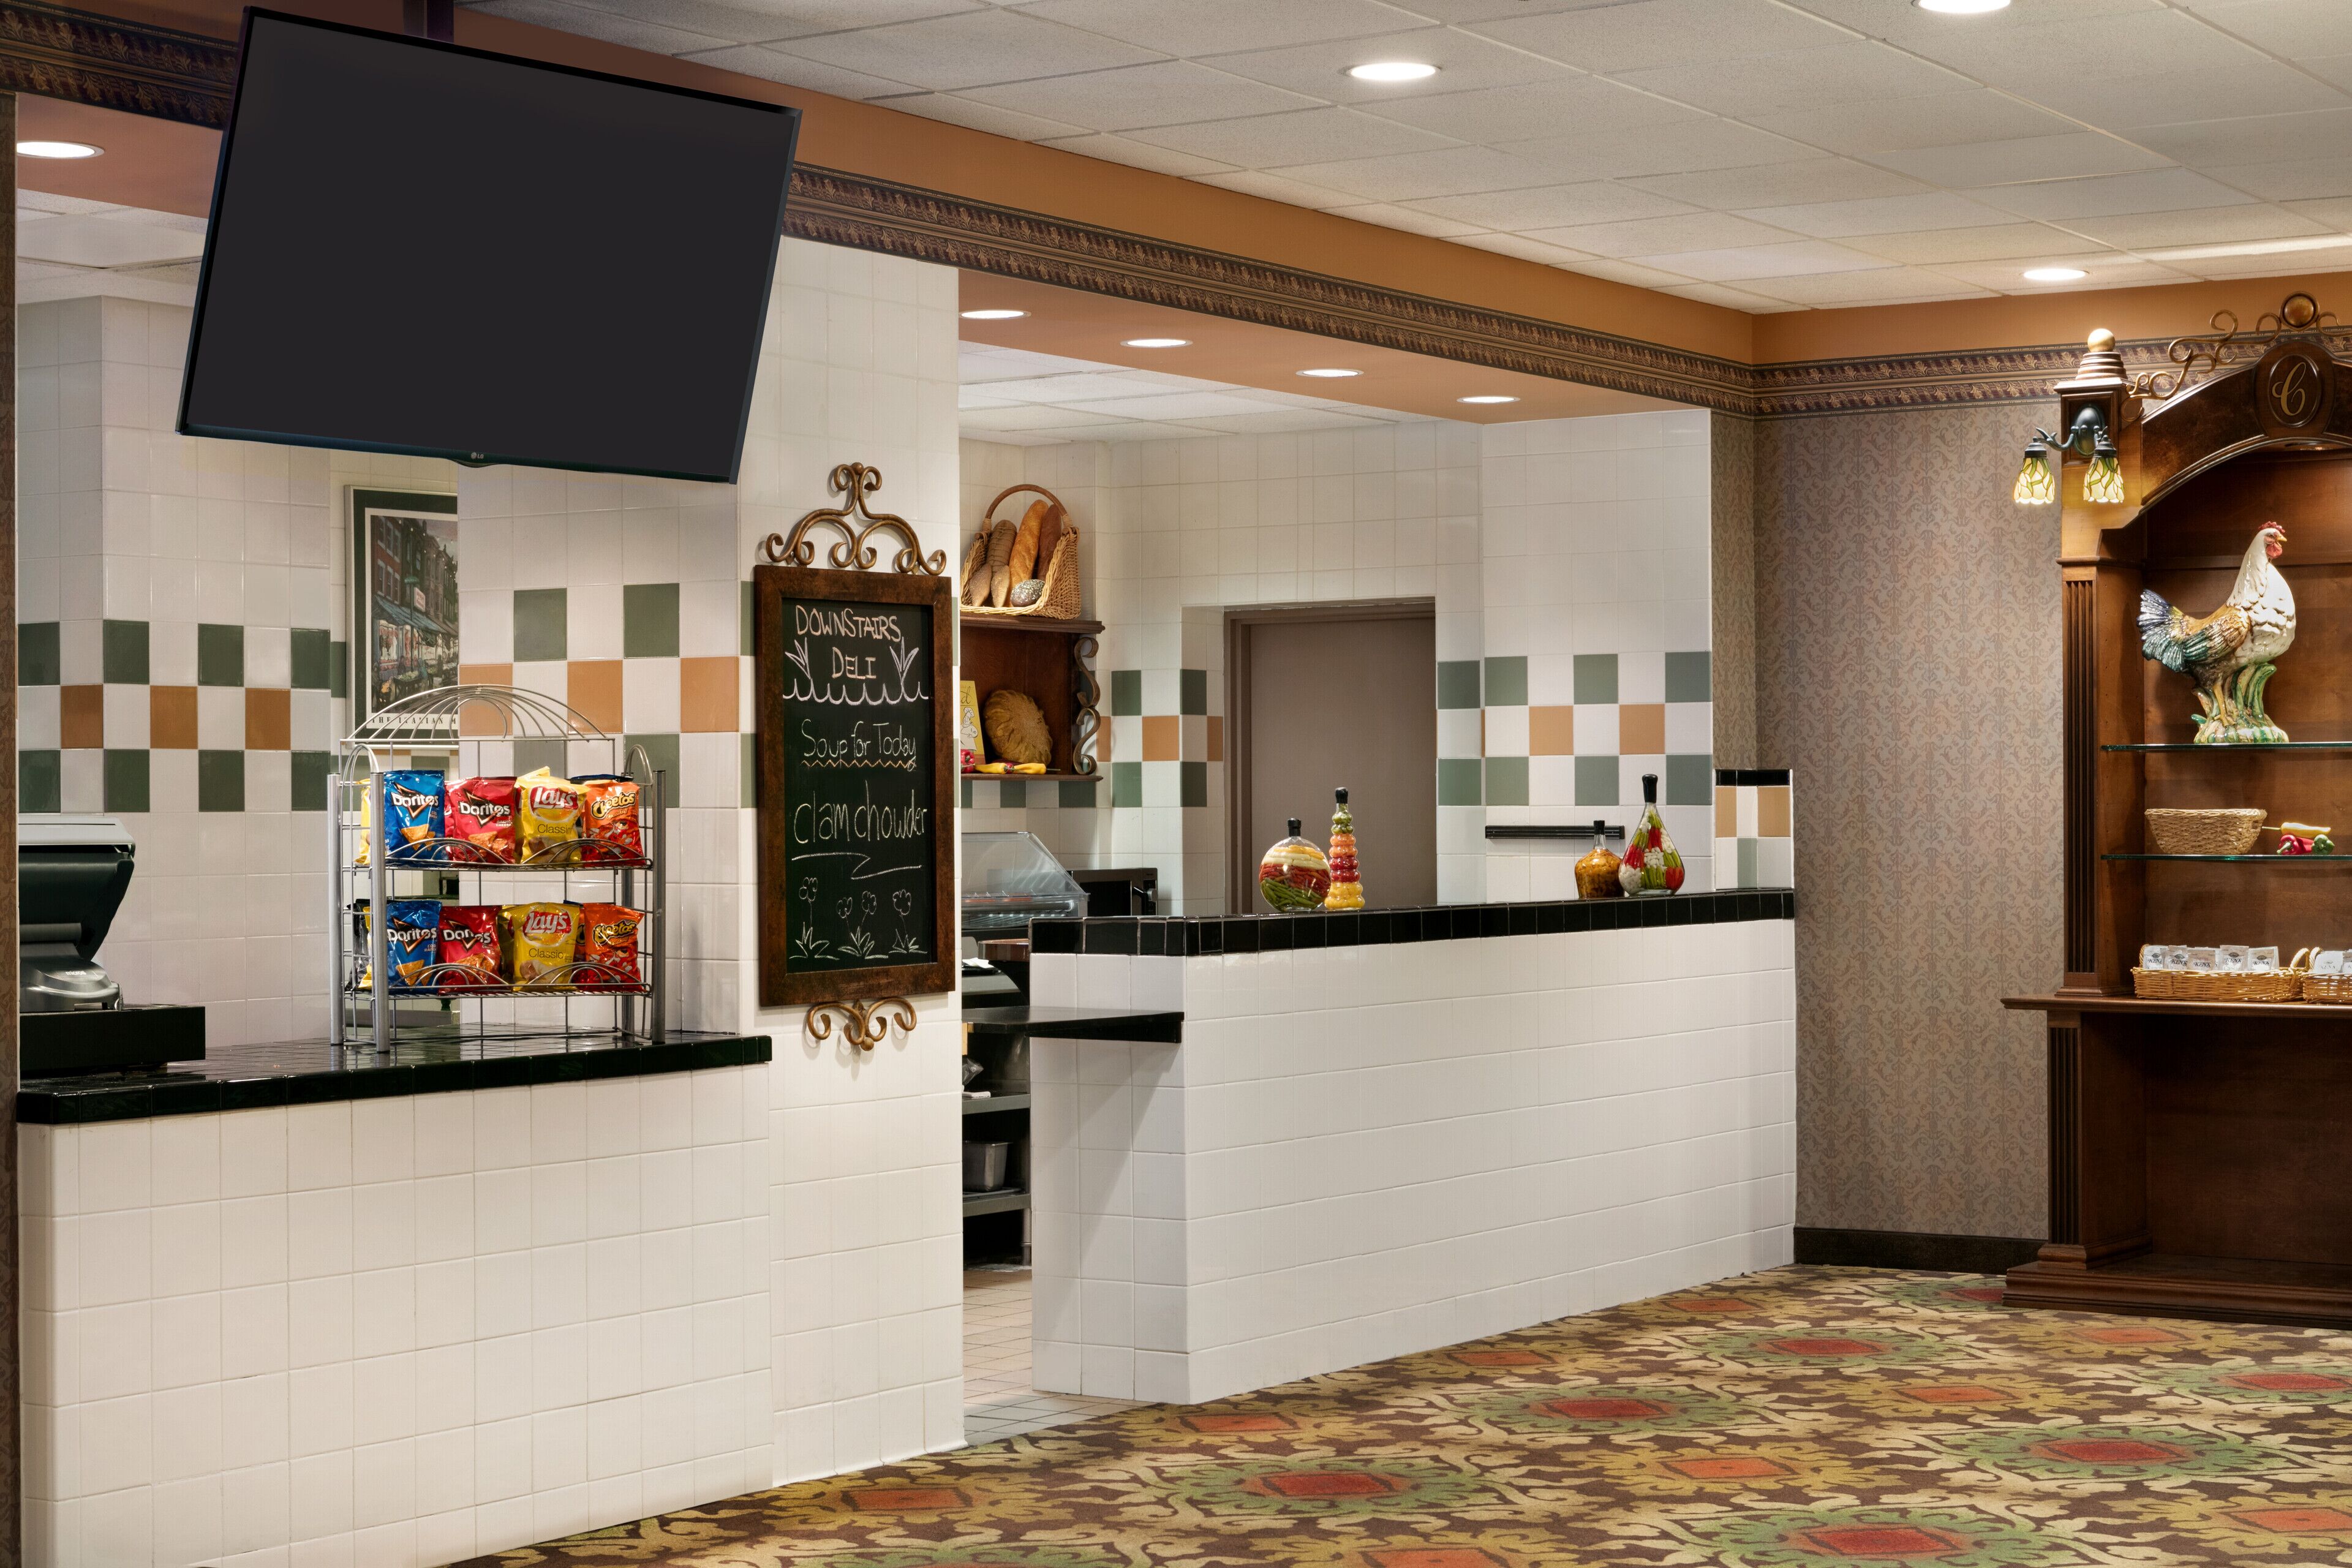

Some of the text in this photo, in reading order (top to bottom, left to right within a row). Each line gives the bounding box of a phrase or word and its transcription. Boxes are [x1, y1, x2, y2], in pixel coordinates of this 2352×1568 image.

[796, 605, 901, 642] DOWNSTAIRS
[832, 647, 876, 679] DELI
[802, 719, 916, 772] Soup for Today
[391, 792, 439, 807] Doritos
[592, 792, 635, 818] Cheetos
[460, 802, 511, 816] Doritos
[854, 780, 927, 842] chowder
[537, 824, 572, 834] Classic
[387, 927, 437, 941] Doritos
[443, 929, 491, 943] Dorios
[529, 948, 564, 960] Classic
